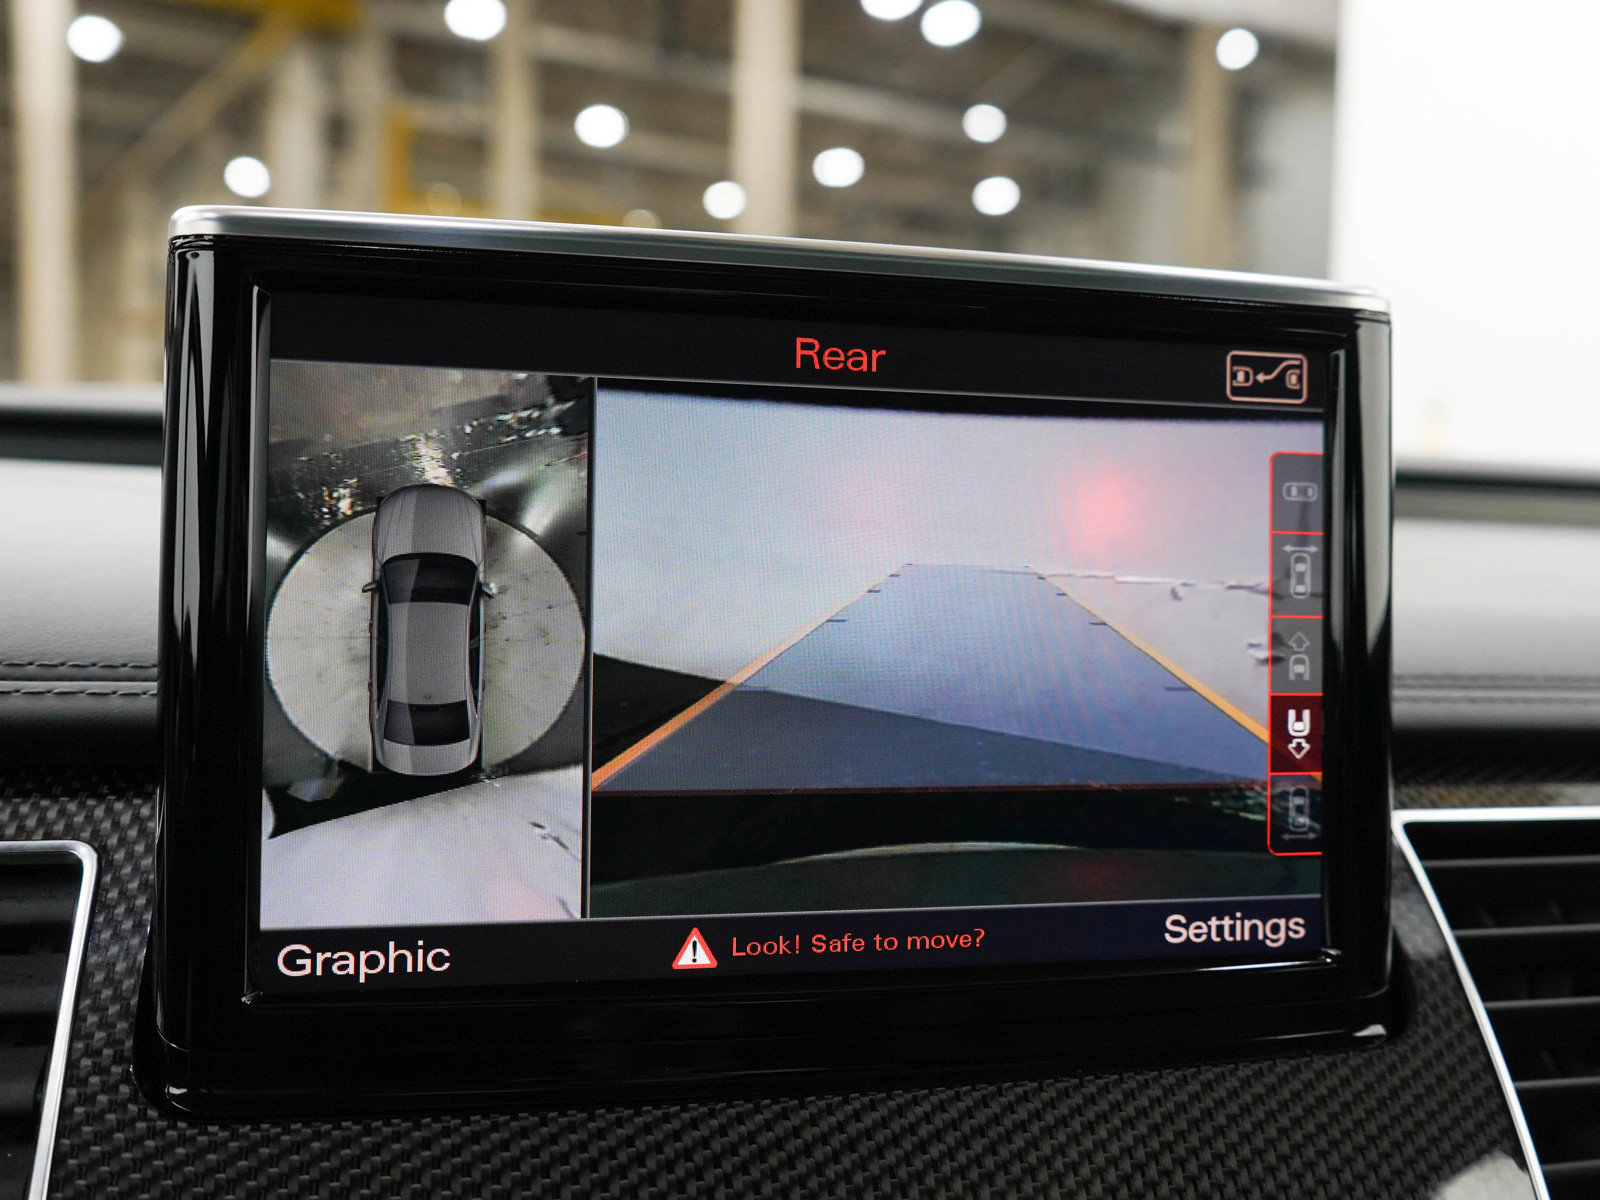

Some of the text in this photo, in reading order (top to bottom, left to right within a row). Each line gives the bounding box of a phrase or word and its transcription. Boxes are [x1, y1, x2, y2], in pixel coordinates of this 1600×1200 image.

[795, 337, 887, 373] Rear
[731, 928, 986, 957] Look! Safe to move?
[1164, 911, 1306, 948] Settings
[277, 939, 451, 984] Graphic
